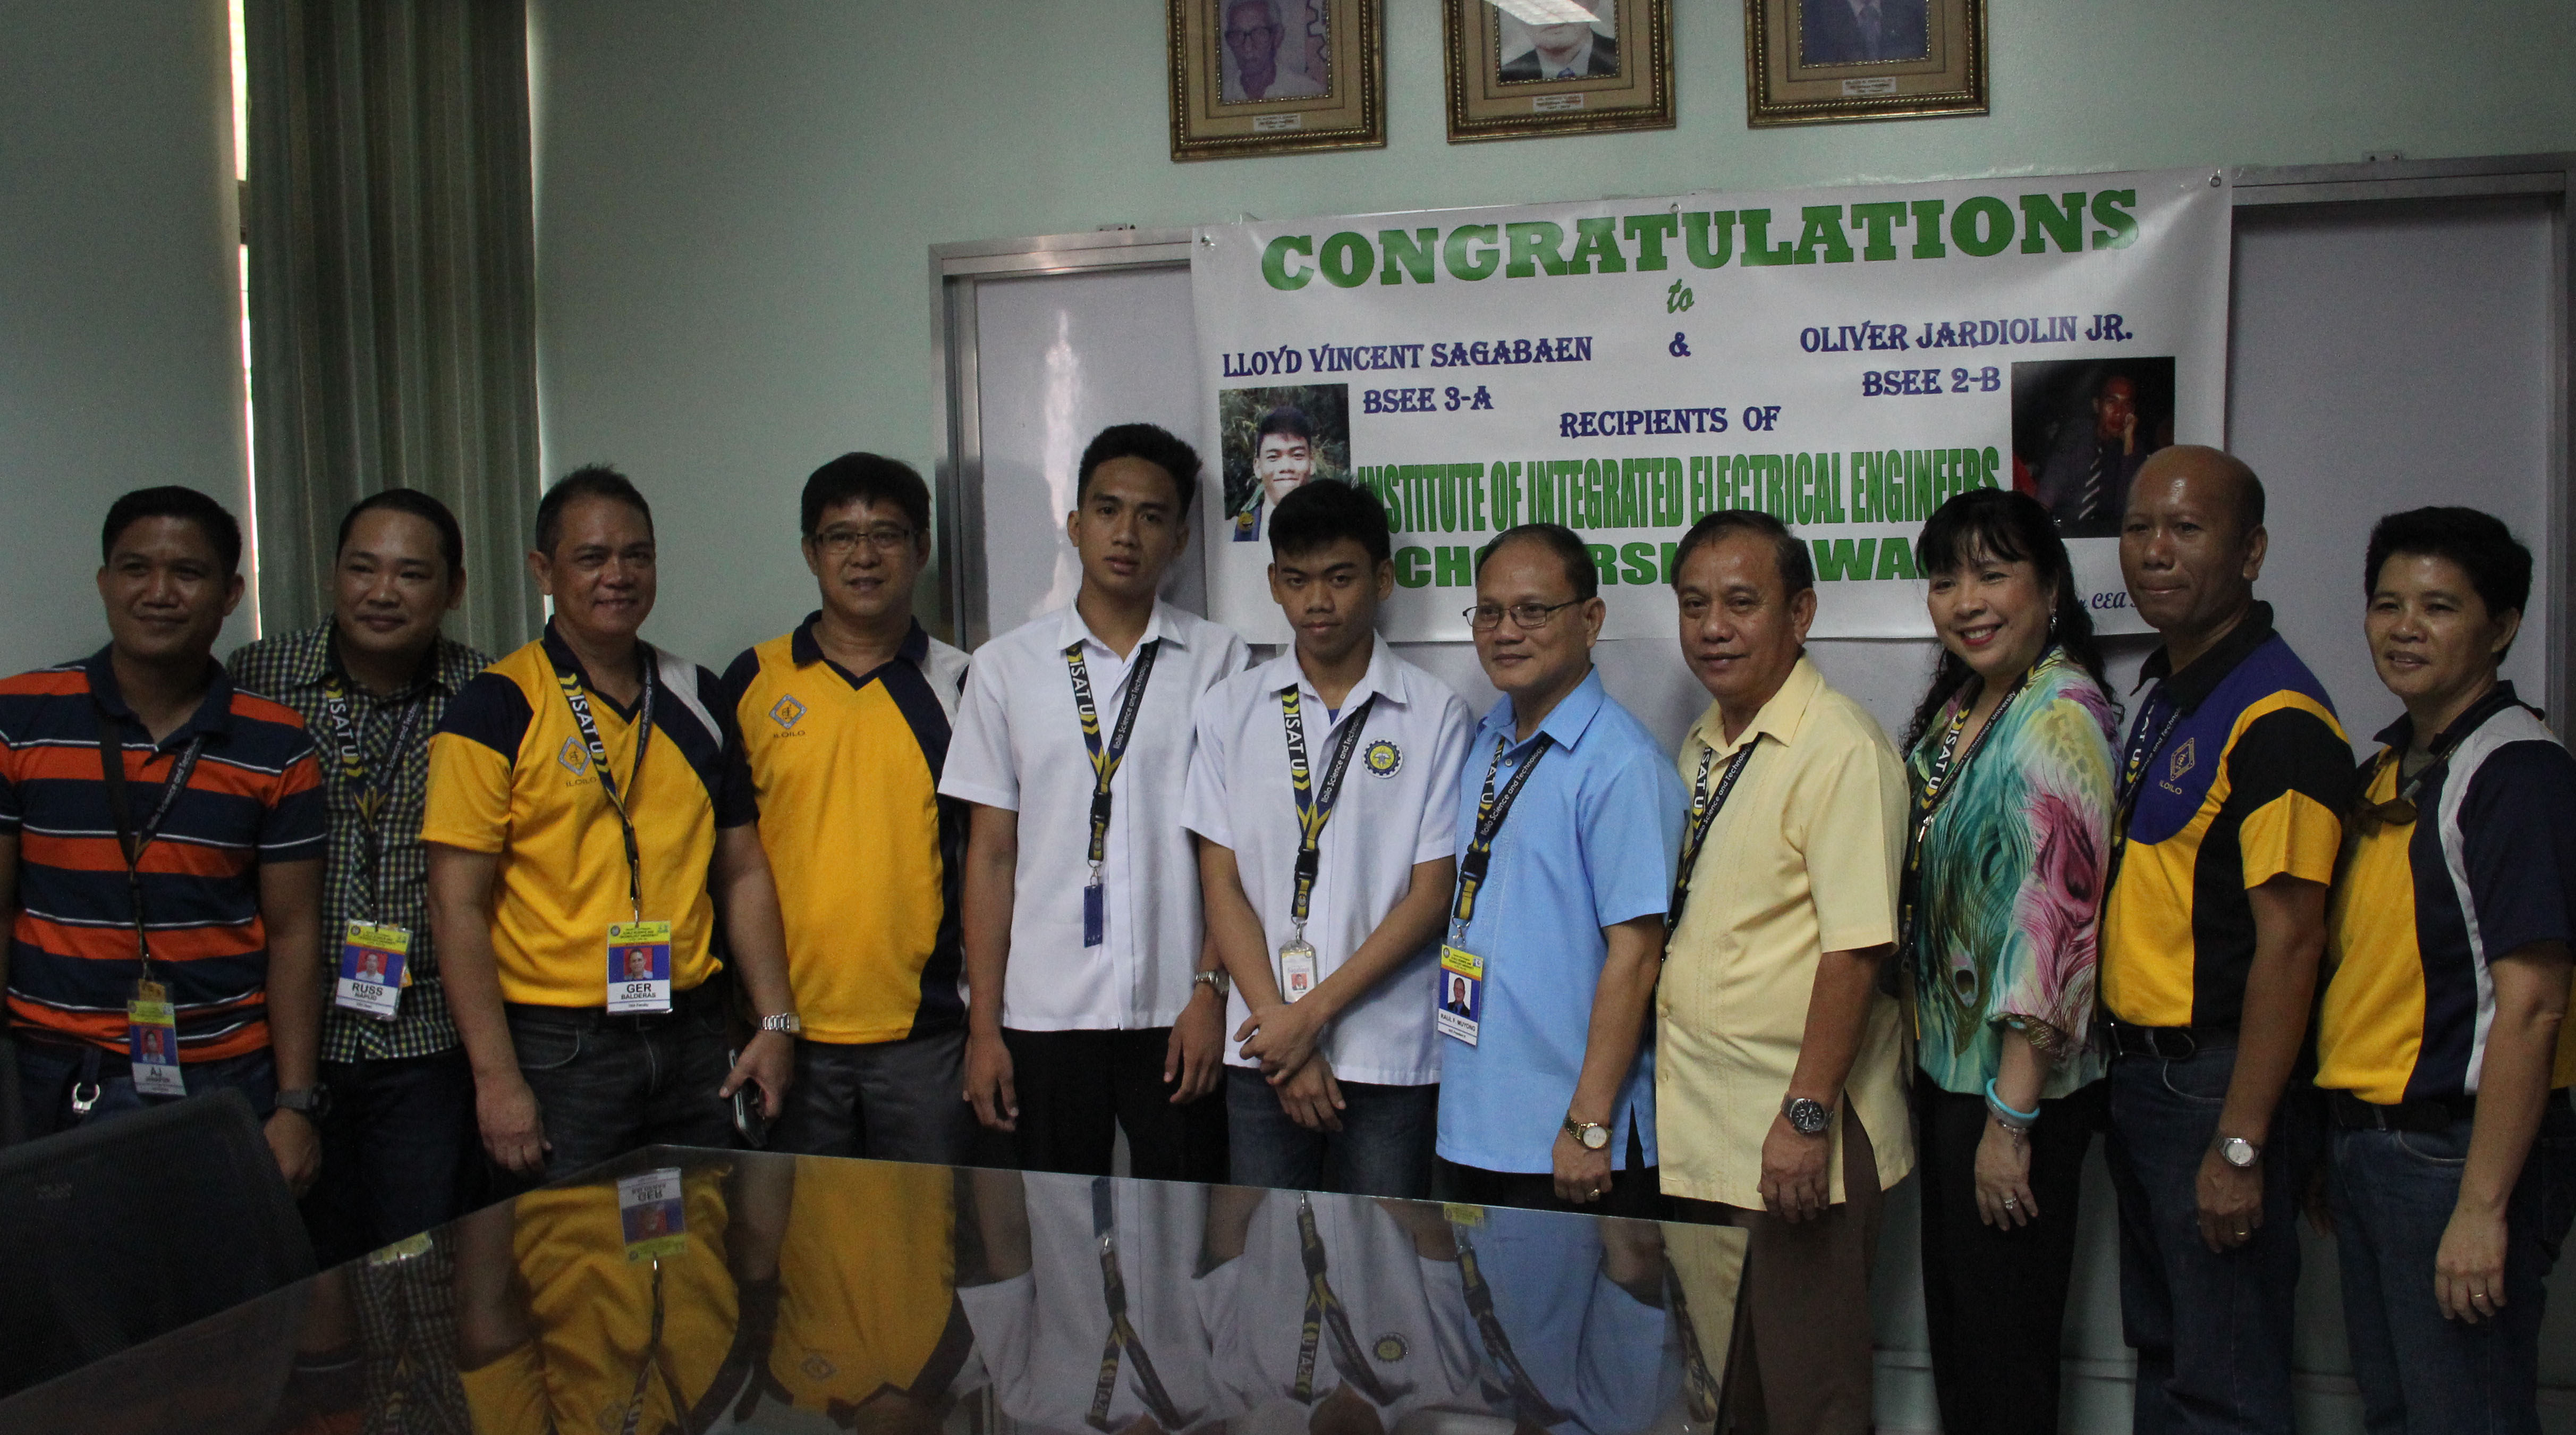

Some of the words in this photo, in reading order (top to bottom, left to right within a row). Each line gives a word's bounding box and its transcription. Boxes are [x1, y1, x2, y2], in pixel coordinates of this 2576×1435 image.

[1261, 189, 2139, 291] CONGRATULATIONS
[1666, 278, 1694, 314] to
[1223, 343, 1303, 377] LLOYD
[1309, 343, 1423, 373] VINCENT
[1430, 335, 1592, 368] SAGABAEN
[1668, 332, 1691, 357] &
[1800, 320, 1910, 353] OLIVER
[1916, 315, 2077, 350] JARDIOLIN
[2084, 313, 2133, 343] JR.
[1862, 369, 1942, 397] BSEE
[1951, 366, 2001, 393] 2-B
[1363, 387, 1437, 414] BSEE
[1443, 385, 1494, 411] 3-A
[1560, 407, 1728, 438] RECIPIENTS
[1743, 406, 1781, 431] OF
[1490, 460, 1522, 531] OF
[1527, 458, 1683, 530] INTEGRATED
[1690, 452, 1845, 526] ELECTRICAL
[2091, 592, 2126, 610] CEA
[1069, 661, 1091, 699] ISAT
[1079, 704, 1095, 715] U
[1128, 693, 1138, 707] and
[1990, 690, 2017, 721] University
[329, 697, 354, 739] ISAT
[569, 695, 598, 736] ISAT
[589, 741, 605, 753] U
[1118, 707, 1132, 734] Science
[1113, 733, 1124, 749] Iloilo
[1285, 713, 1304, 754] ISAT
[341, 745, 359, 757] U
[1291, 758, 1307, 770] U
[1339, 746, 1350, 761] and
[1935, 729, 1960, 772] ISAT
[2132, 748, 2142, 761] U
[1326, 759, 1343, 787] Science
[1485, 749, 1502, 786] ISAT
[1697, 748, 1711, 790] ISAT
[565, 776, 597, 787] ILOILO
[1320, 787, 1333, 803] Iloilo
[1480, 821, 1494, 835] Iloilo
[1489, 794, 1510, 821] Science
[1507, 780, 1519, 795] and
[1515, 745, 1545, 781] Technology
[1703, 796, 1720, 824] Science
[1718, 781, 1728, 795] and
[1725, 743, 1752, 783] Technolog
[1928, 776, 1942, 790] U
[2159, 779, 2182, 795] ILOILO
[1481, 792, 1494, 803] U
[1693, 796, 1705, 808] U
[352, 982, 383, 997] RUSS
[626, 983, 651, 993] GER
[1440, 1013, 1452, 1022] RAUL
